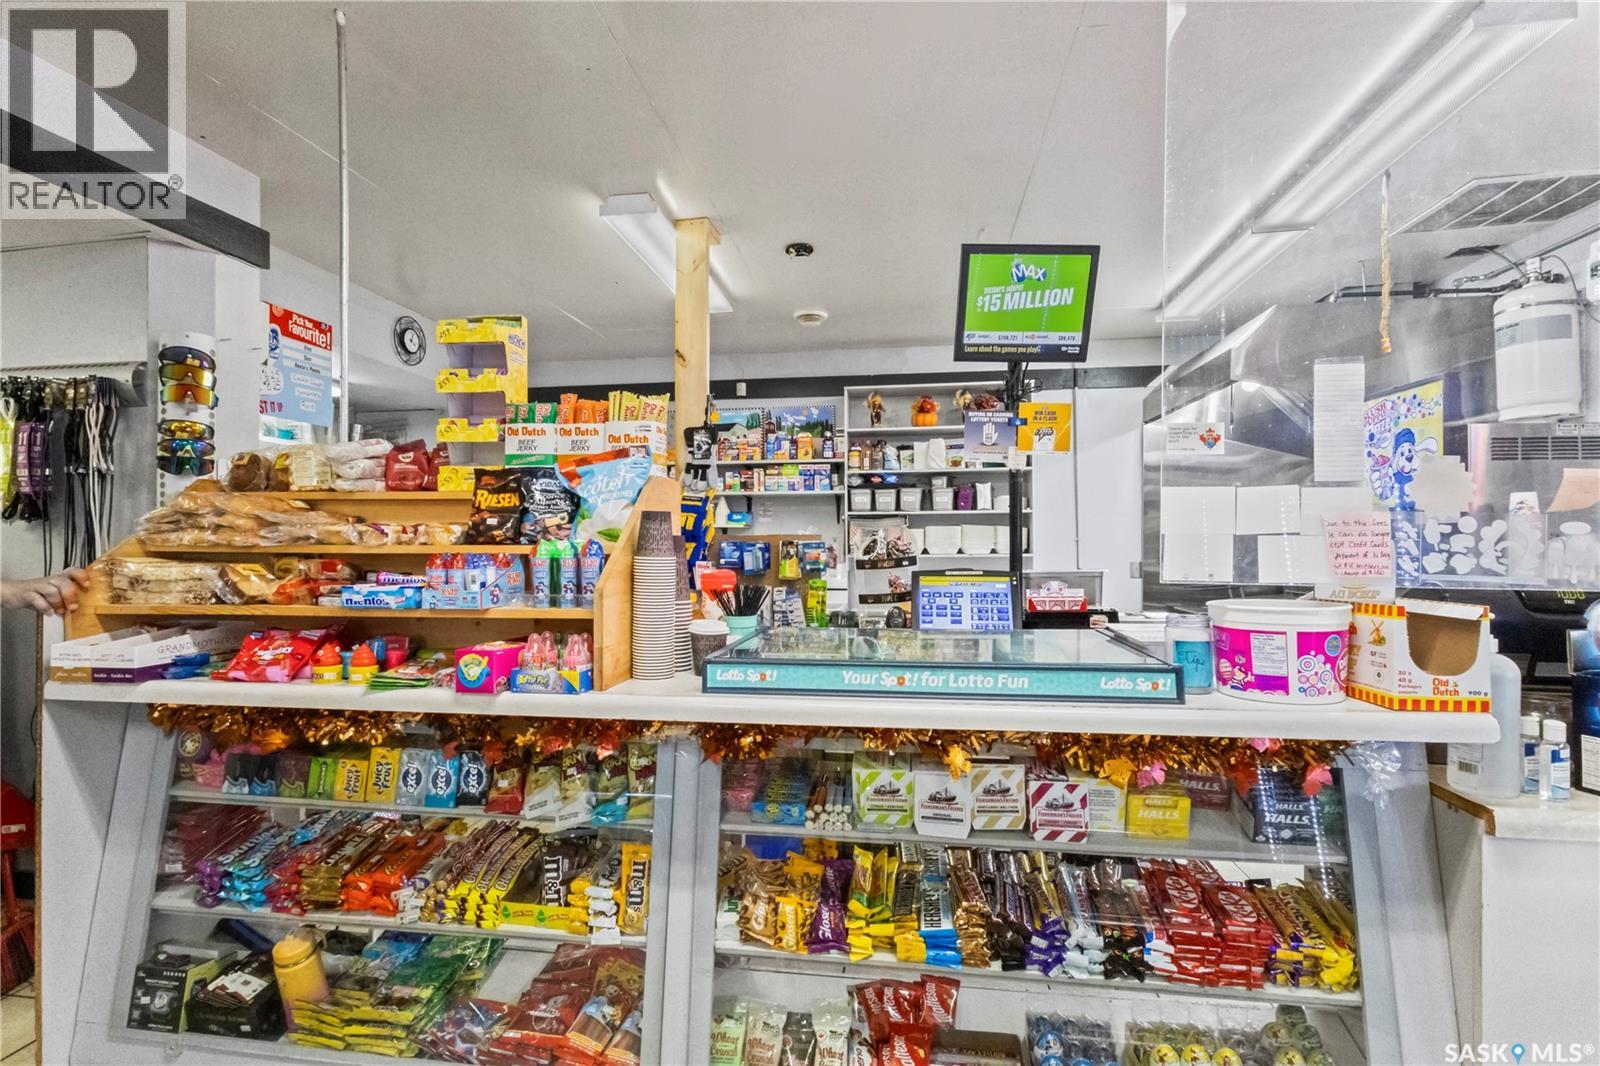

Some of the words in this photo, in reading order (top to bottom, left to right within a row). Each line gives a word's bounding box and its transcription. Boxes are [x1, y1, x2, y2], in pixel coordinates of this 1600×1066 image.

[1011, 262, 1047, 283] MAX
[976, 293, 1001, 312] $15
[1002, 287, 1074, 311] MILLION
[292, 314, 304, 325] Pick
[288, 320, 331, 350] Favourite!
[1001, 346, 1016, 354] games
[507, 427, 519, 437] Old
[522, 426, 546, 437] Dutch
[559, 427, 572, 437] Old
[575, 426, 599, 437] Dutch
[608, 434, 621, 444] Old
[624, 433, 649, 444] Dutch
[474, 490, 520, 510] RIESEN
[383, 575, 427, 584] mentos
[345, 597, 389, 606] mentos
[716, 669, 744, 682] Lotto
[746, 669, 777, 683] Spot!
[842, 670, 877, 685] Your
[880, 671, 918, 688] Spot!
[921, 671, 946, 687] for
[949, 673, 993, 689] Lotto
[998, 674, 1029, 689] Fun
[1432, 678, 1449, 688] Old
[1100, 677, 1133, 690] Lotto
[1136, 677, 1171, 692] Spot!
[1432, 687, 1460, 697] Dutch
[344, 767, 352, 794] Juicy
[352, 767, 362, 794] Fruit
[373, 761, 383, 790] Juicy
[382, 761, 392, 790] Fruit
[407, 761, 417, 793] excel
[437, 764, 447, 796] excel
[469, 763, 479, 794] excel
[1138, 808, 1180, 820] HALLS
[1275, 803, 1304, 811] HALLS
[1265, 814, 1311, 825] HALLS
[601, 857, 622, 882] Aero
[924, 887, 942, 928] HERSHEY'S
[711, 1031, 740, 1045] Wheat
[747, 1038, 776, 1051] Wheat
[710, 1045, 738, 1058] Crunch
[818, 1047, 844, 1061] Wheat
